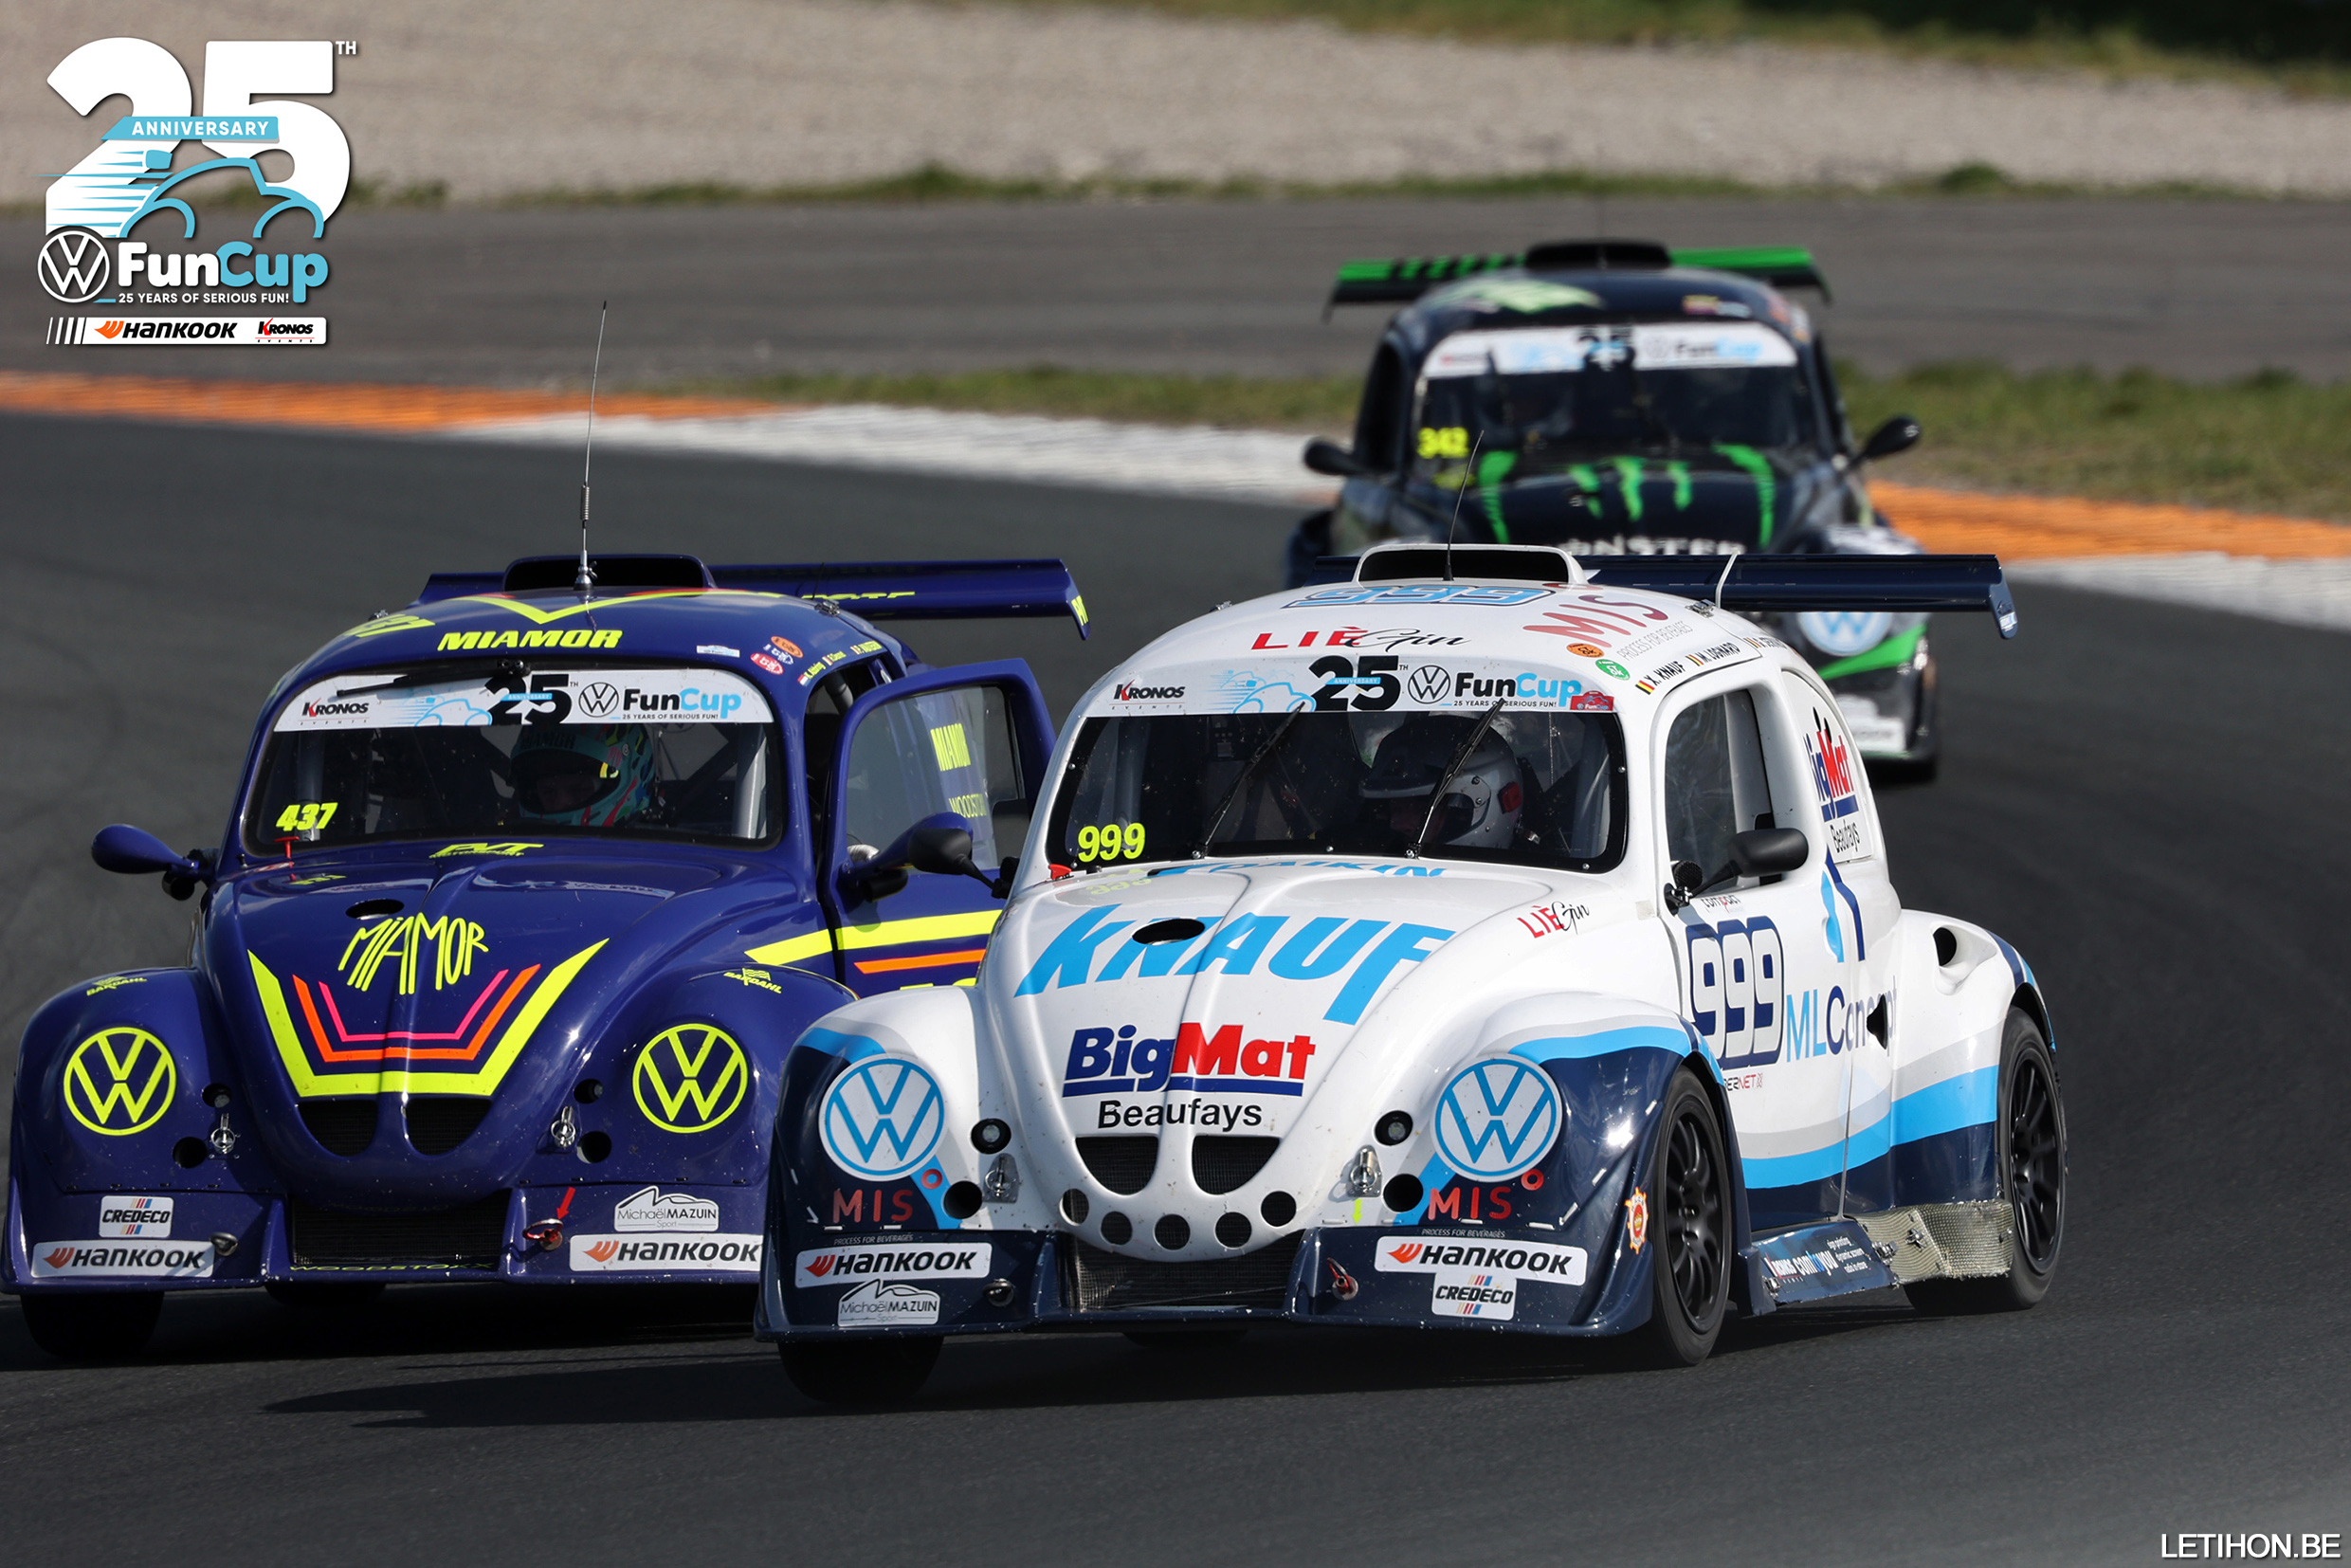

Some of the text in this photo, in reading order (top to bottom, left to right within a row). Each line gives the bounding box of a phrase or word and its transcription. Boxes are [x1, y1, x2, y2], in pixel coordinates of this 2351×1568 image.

[1280, 585, 1556, 609] 999
[437, 629, 623, 651] MIAMOR
[1308, 655, 1401, 711] 25
[1657, 661, 1686, 681] KNAUF
[484, 674, 573, 724] 25
[623, 687, 742, 719] FunCup
[1113, 679, 1186, 701] KRONOS
[1454, 672, 1581, 707] FunCup
[301, 697, 370, 718] KRONOS
[275, 802, 338, 831] 437
[1078, 822, 1146, 863] 999
[337, 912, 489, 995] MIAMOR
[1013, 903, 1456, 1026] KNAUF
[1687, 919, 1783, 1066] 999
[1064, 1022, 1316, 1092] BigMat
[1098, 1098, 1263, 1132] Beaufays
[101, 1209, 171, 1224] CREDECO
[657, 1220, 677, 1229] Sport
[863, 1235, 876, 1244] FOR
[1467, 1230, 1506, 1238] BEVERAGES
[1435, 1285, 1514, 1304] CREDECO
